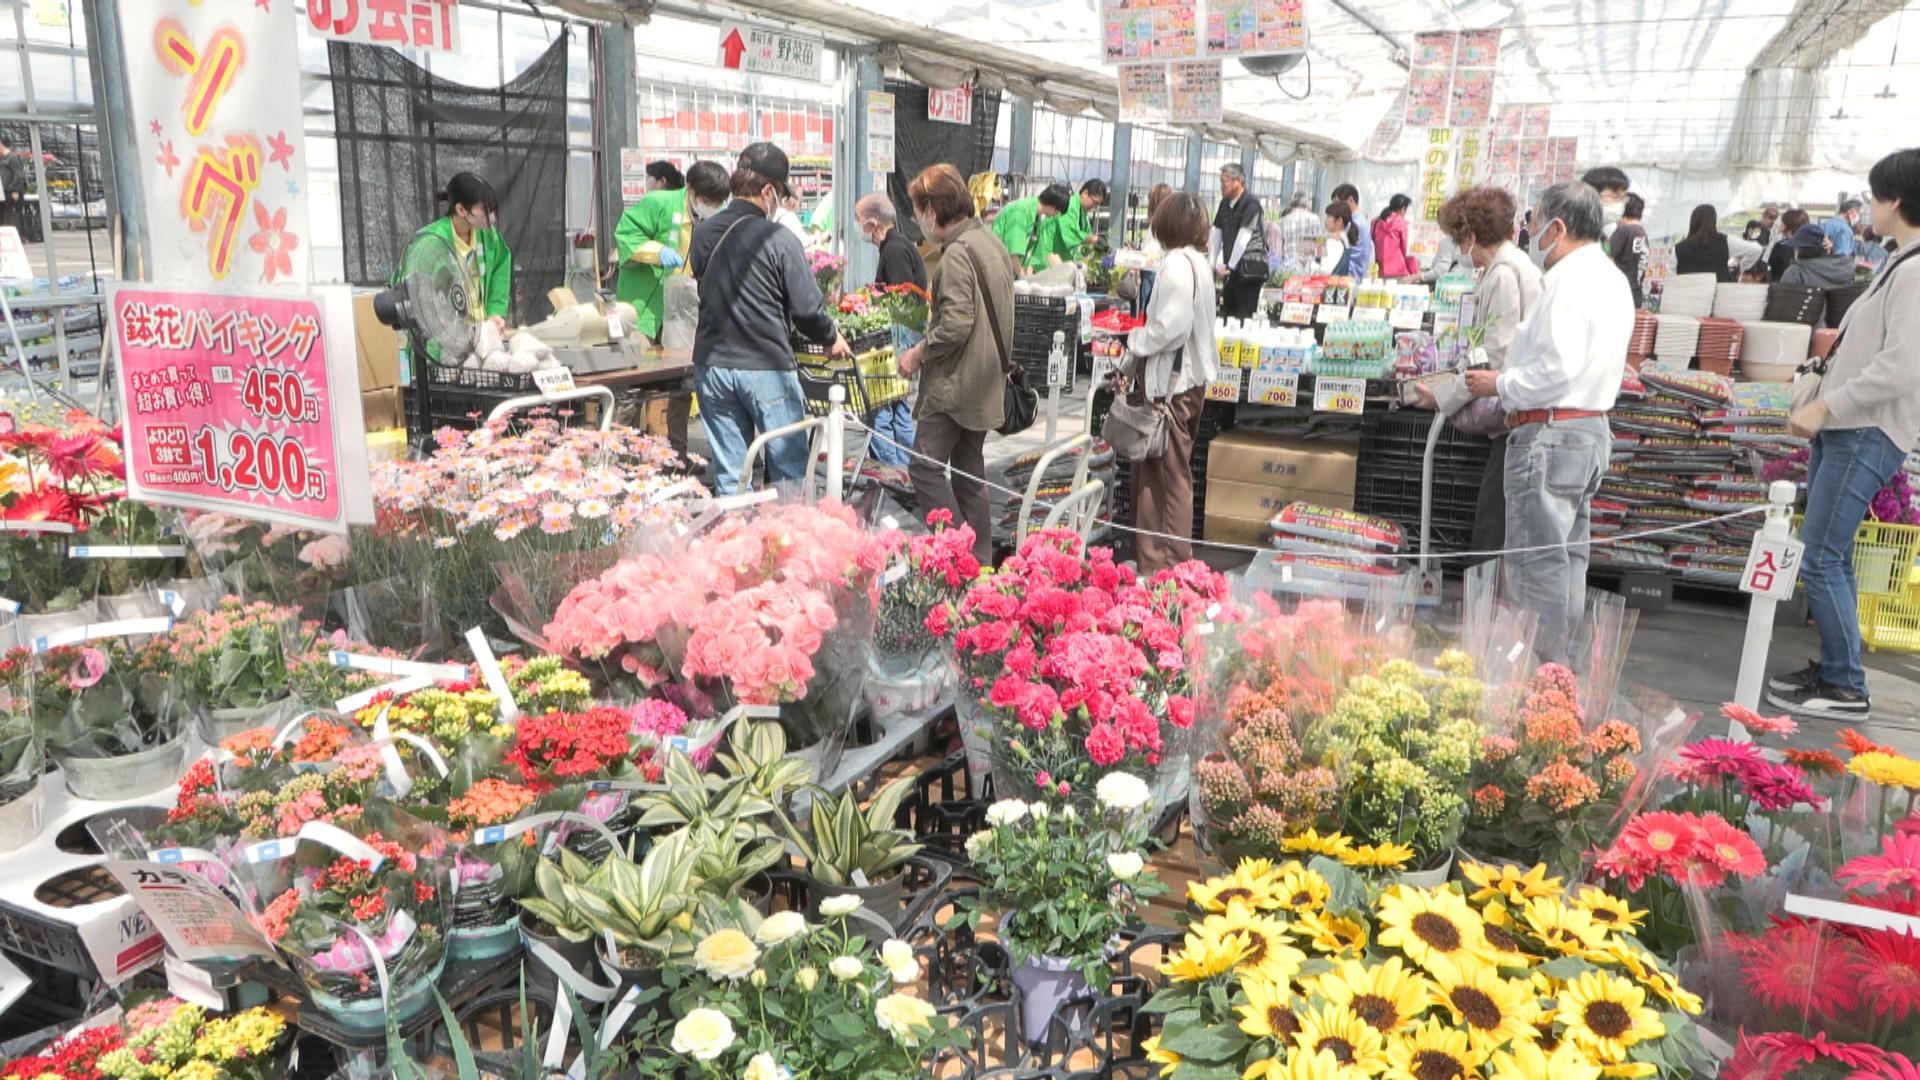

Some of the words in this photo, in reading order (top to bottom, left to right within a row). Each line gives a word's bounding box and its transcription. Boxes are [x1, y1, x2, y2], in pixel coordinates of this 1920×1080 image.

[121, 300, 319, 362] 鉢花バイキング
[243, 366, 320, 421] 450円
[147, 427, 187, 446] よりどり
[194, 426, 327, 499] 1,200円
[1262, 461, 1297, 476] 活力液
[1750, 550, 1777, 592] 入口
[118, 912, 153, 943] NE
